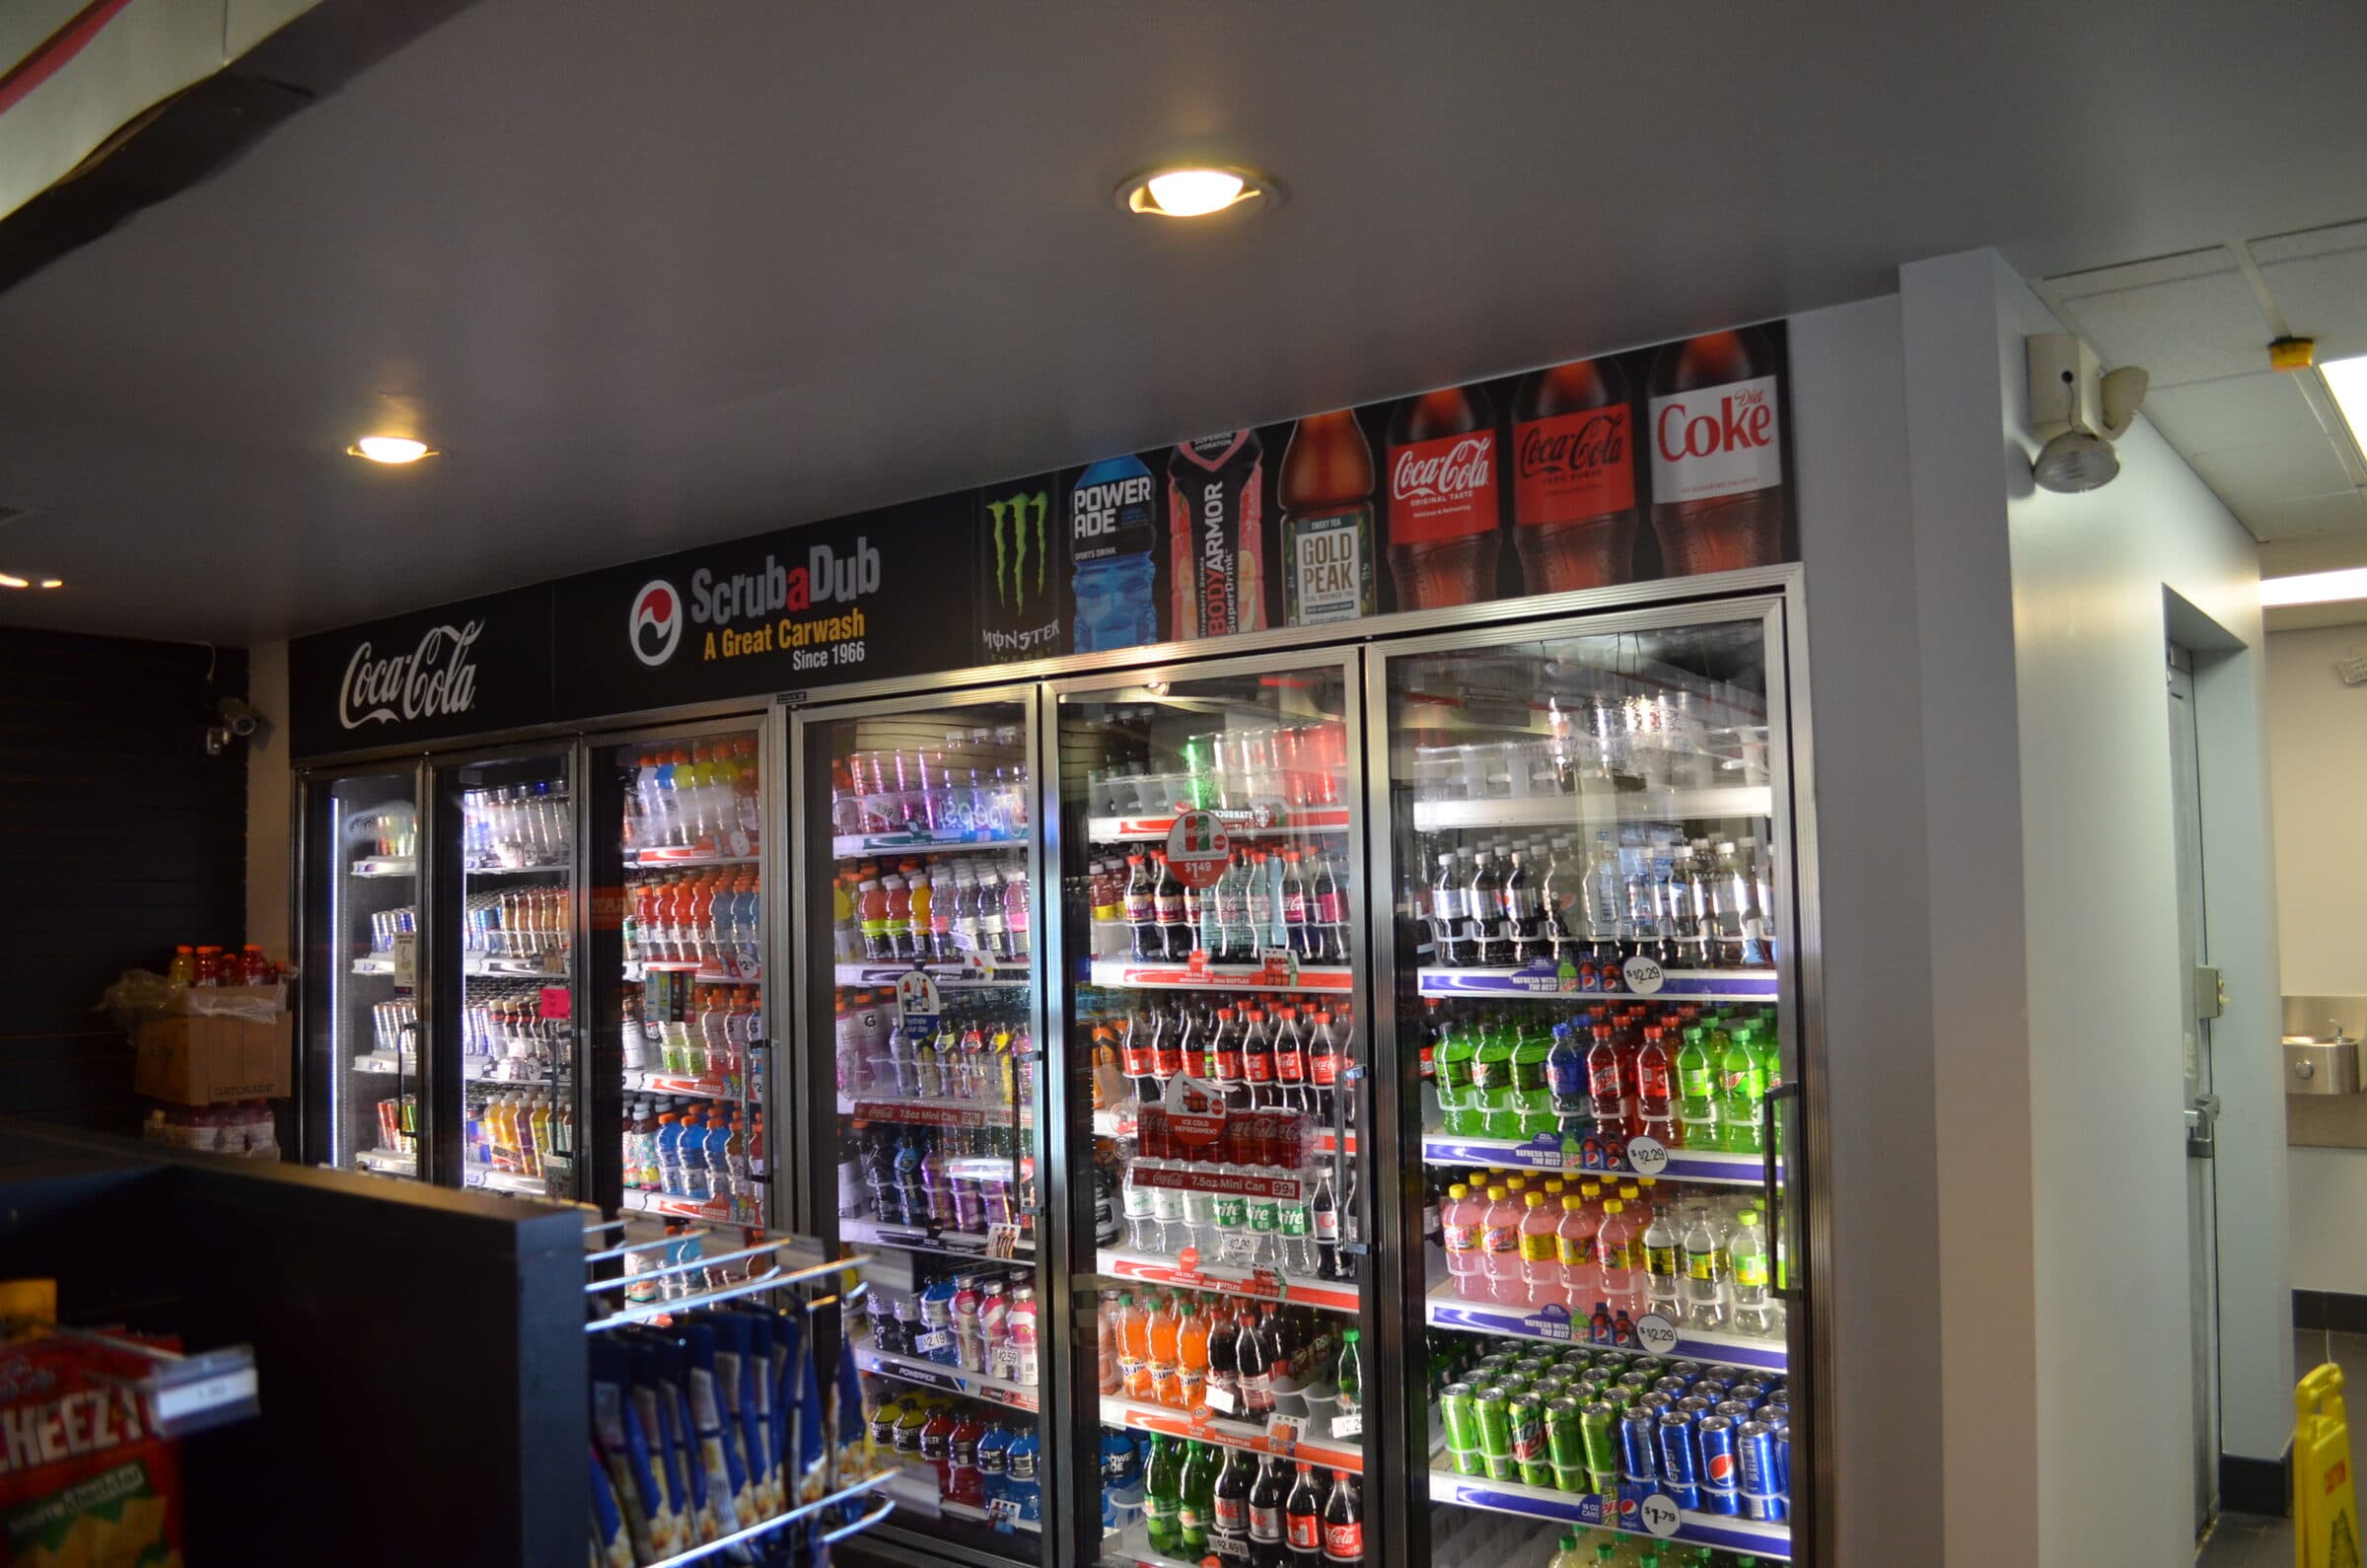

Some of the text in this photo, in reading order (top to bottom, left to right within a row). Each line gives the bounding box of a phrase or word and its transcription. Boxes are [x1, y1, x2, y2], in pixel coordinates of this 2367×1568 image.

[1734, 389, 1763, 407] Diet
[1658, 396, 1771, 463] Coke
[1194, 439, 1233, 452] HYDRATION
[1520, 413, 1625, 478] Coca-Cola
[1394, 437, 1491, 501] Coca-Cola
[1074, 476, 1151, 515] POWER
[1410, 491, 1473, 507] ORIGINAL TASTE
[1074, 508, 1117, 539] ADE
[1204, 481, 1229, 636] BODYARMOR
[1303, 533, 1352, 566] GOLD
[691, 536, 881, 625] ScrubaDub
[1303, 562, 1353, 595] PEAK
[703, 607, 866, 661] A Great Carwash
[982, 619, 1060, 652] MONSTER
[793, 641, 865, 671] Since 1966
[339, 618, 485, 730] Coca-Cola
[1633, 966, 1661, 982] $2.29
[922, 1111, 939, 1121] Mini
[1175, 1124, 1217, 1134] REFRESHMENT
[1544, 1151, 1561, 1160] WITH
[1544, 1158, 1561, 1167] BEST
[1637, 1148, 1665, 1164] $2.29
[1152, 1171, 1184, 1185] Coca-Cola
[1191, 1176, 1218, 1188] 7.5oz
[1220, 1178, 1243, 1190] Mini
[1245, 1181, 1265, 1192] Can
[1552, 1322, 1570, 1331] WITH
[1552, 1328, 1570, 1339] BEST
[1646, 1327, 1674, 1343] $2.29
[1644, 1506, 1676, 1525] $1.79
